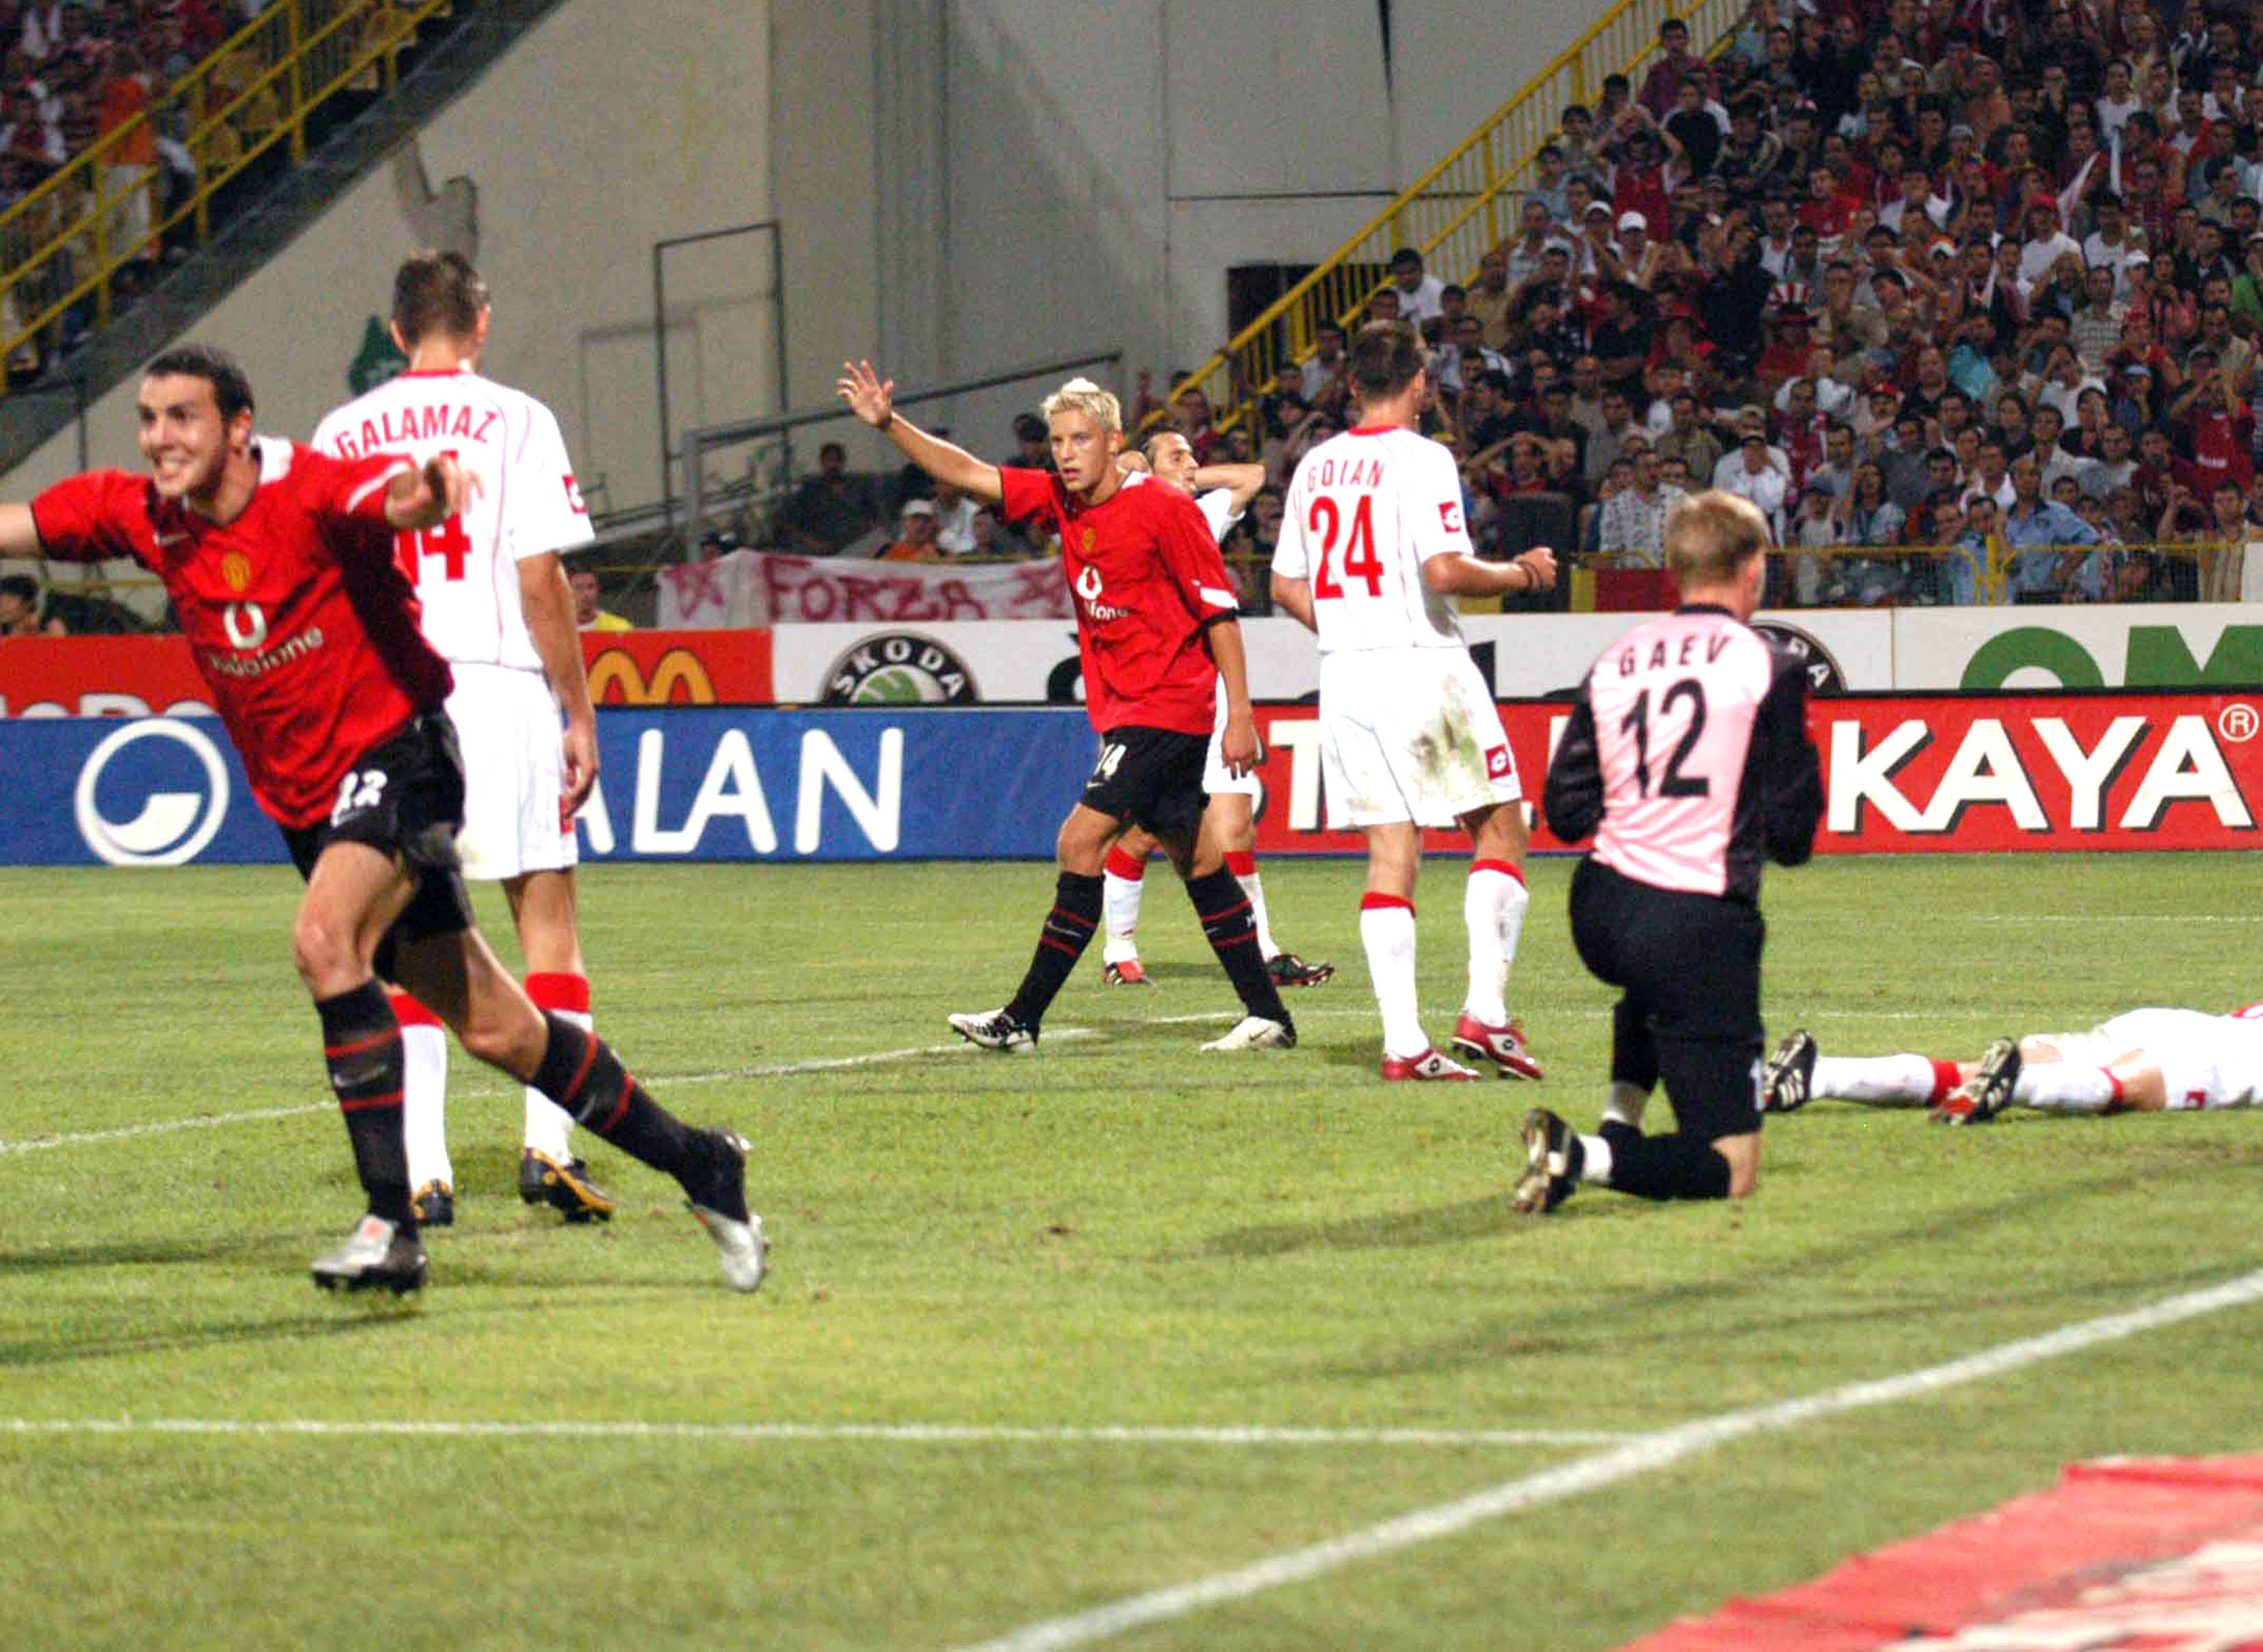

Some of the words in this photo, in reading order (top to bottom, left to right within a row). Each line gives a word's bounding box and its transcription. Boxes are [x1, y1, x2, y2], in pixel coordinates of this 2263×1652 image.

[335, 404, 499, 461] GALAMAZ
[1308, 459, 1384, 493] GOIAN
[1309, 494, 1384, 599] 24
[761, 556, 987, 622] FORZA
[1619, 634, 1733, 678] GAEV
[1620, 678, 1708, 799] 12
